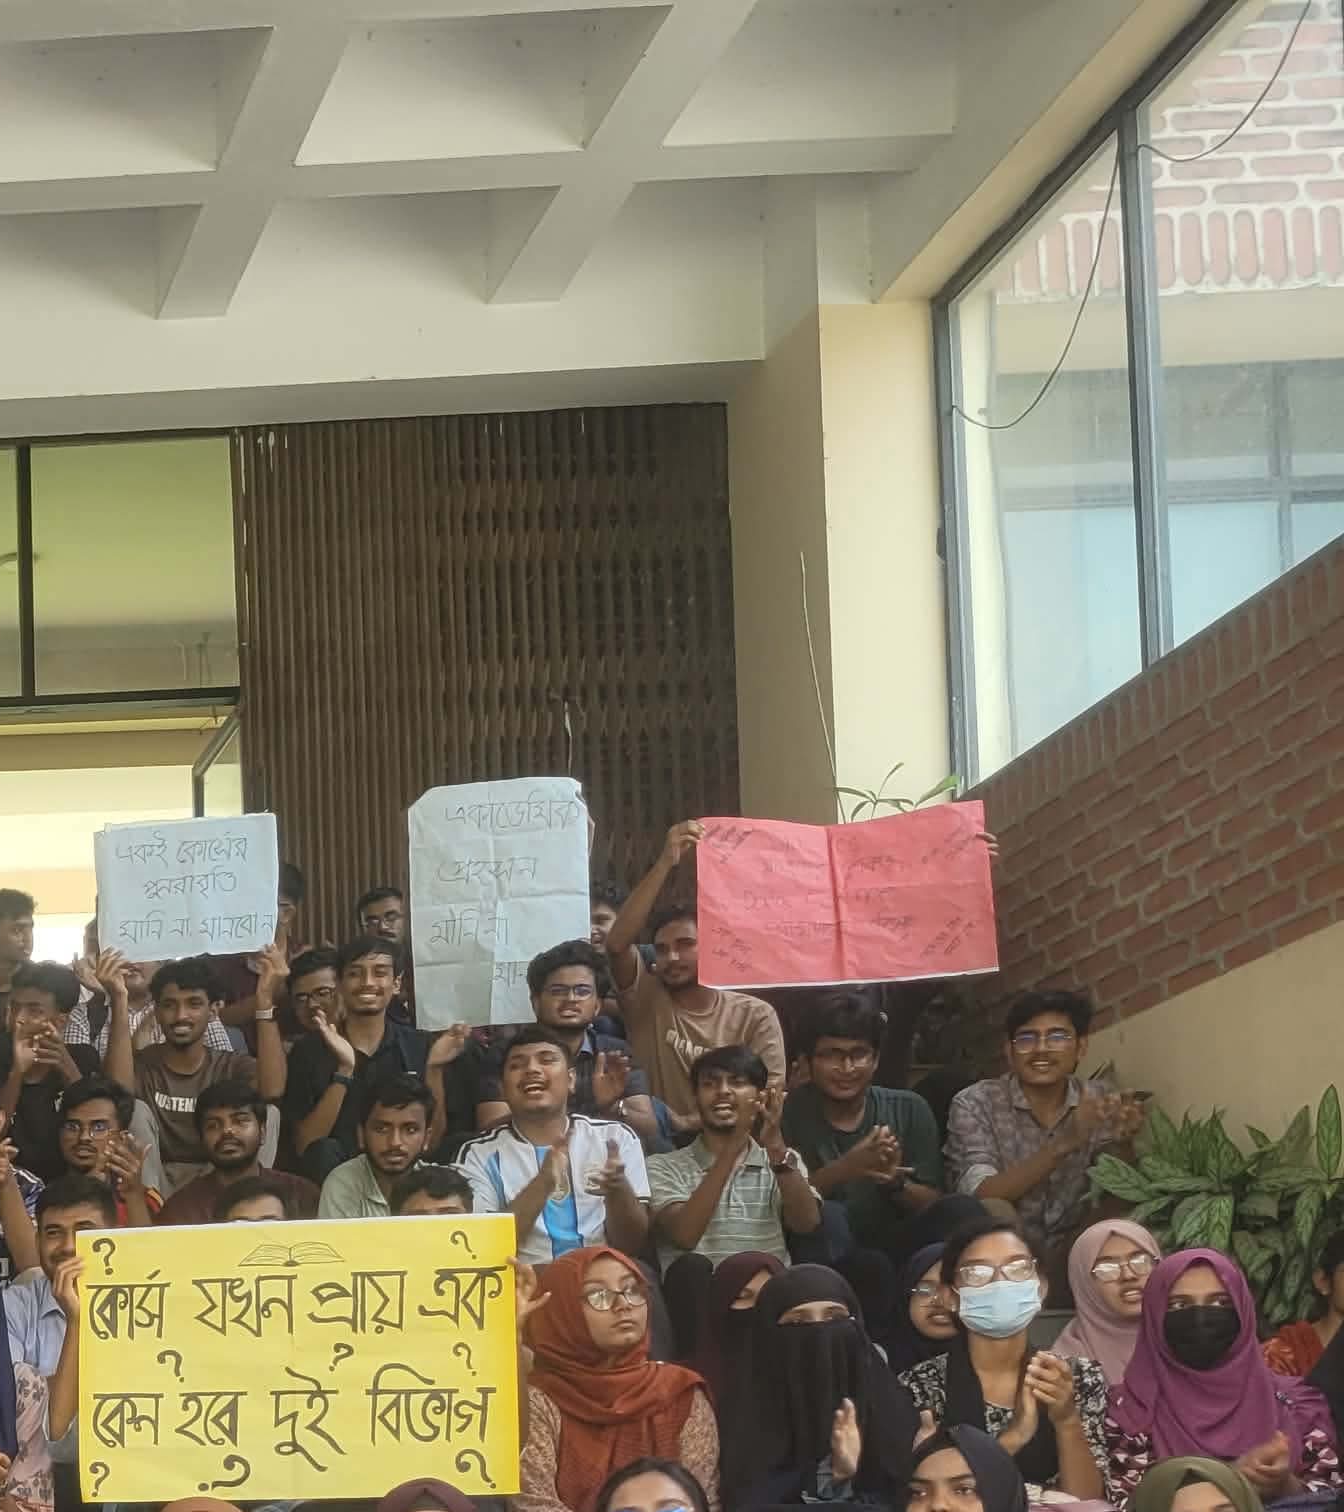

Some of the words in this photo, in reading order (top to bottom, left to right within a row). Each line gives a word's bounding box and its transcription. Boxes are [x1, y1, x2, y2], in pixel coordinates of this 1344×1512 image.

[87, 1269, 172, 1341] কোর্স
[191, 1273, 298, 1338] যখন
[306, 1270, 409, 1336] প্রায়
[417, 1264, 509, 1331] এক
[92, 1391, 164, 1449] কেন
[174, 1390, 248, 1448] হবে
[269, 1366, 348, 1473] দুই
[365, 1362, 498, 1446] বিভাগ
